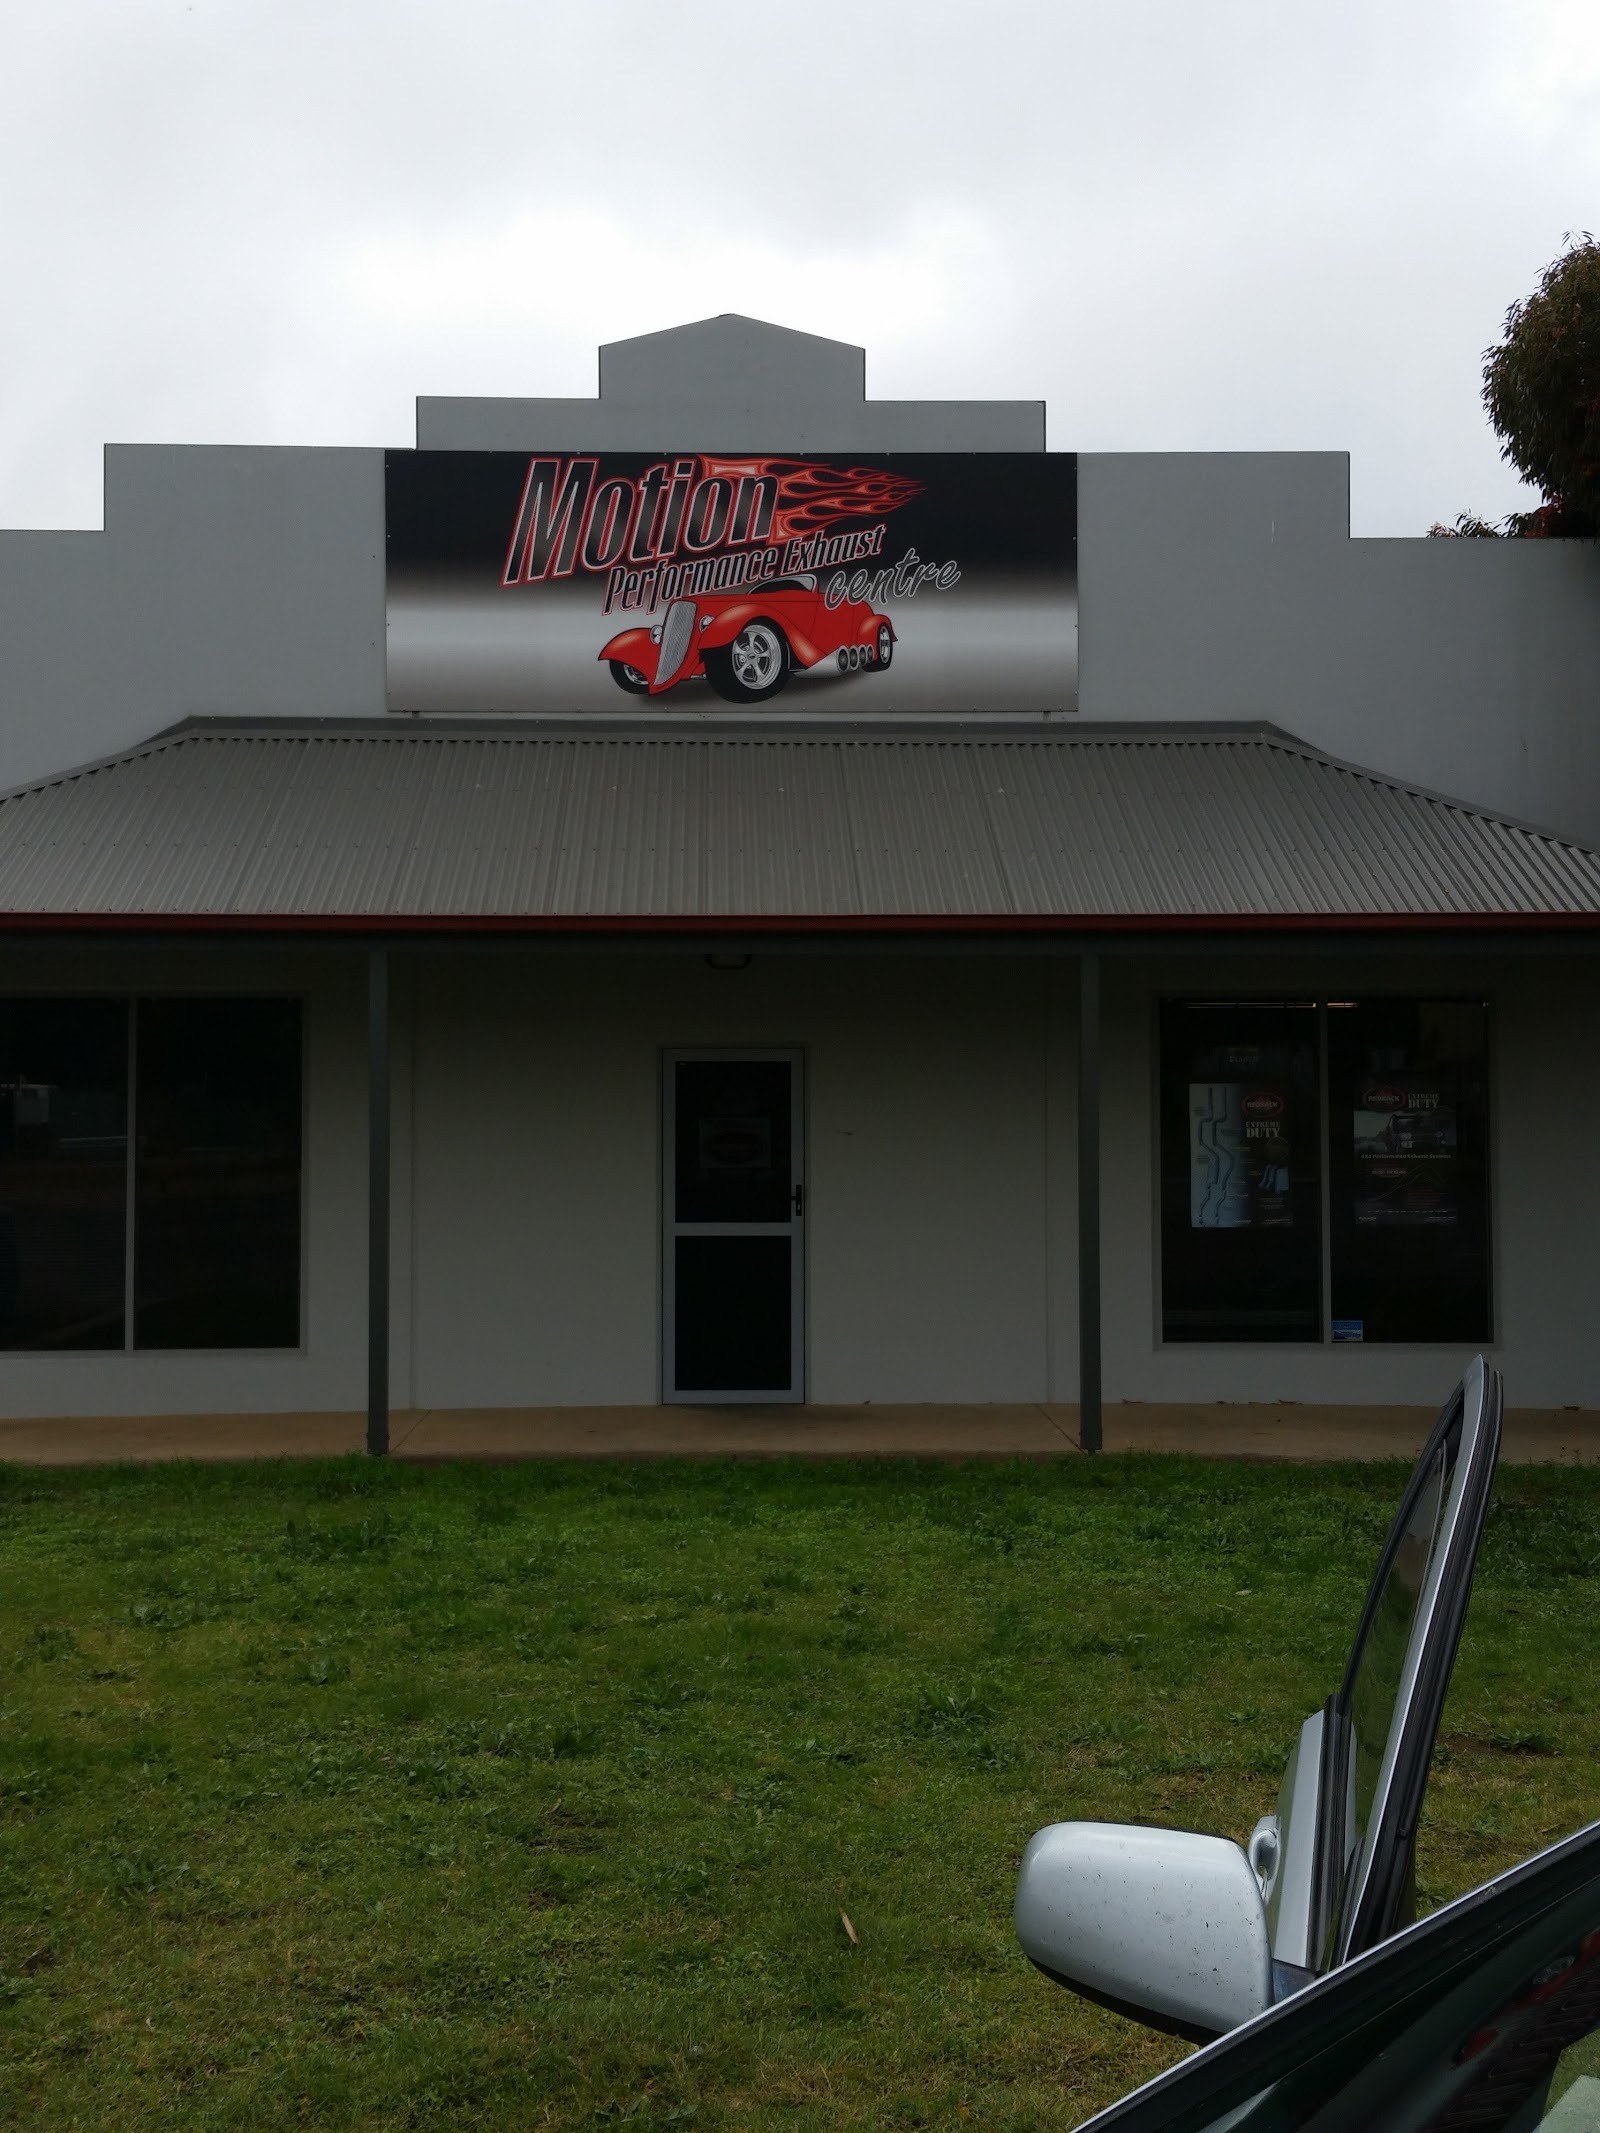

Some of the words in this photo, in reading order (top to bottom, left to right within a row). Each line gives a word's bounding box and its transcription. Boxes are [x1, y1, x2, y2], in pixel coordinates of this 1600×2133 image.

[502, 457, 780, 588] Motion
[602, 542, 780, 616] Performance
[780, 524, 887, 577] Exhaust
[824, 548, 962, 611] centre
[1245, 1127, 1281, 1138] DUTY
[1408, 1099, 1440, 1109] DUTY
